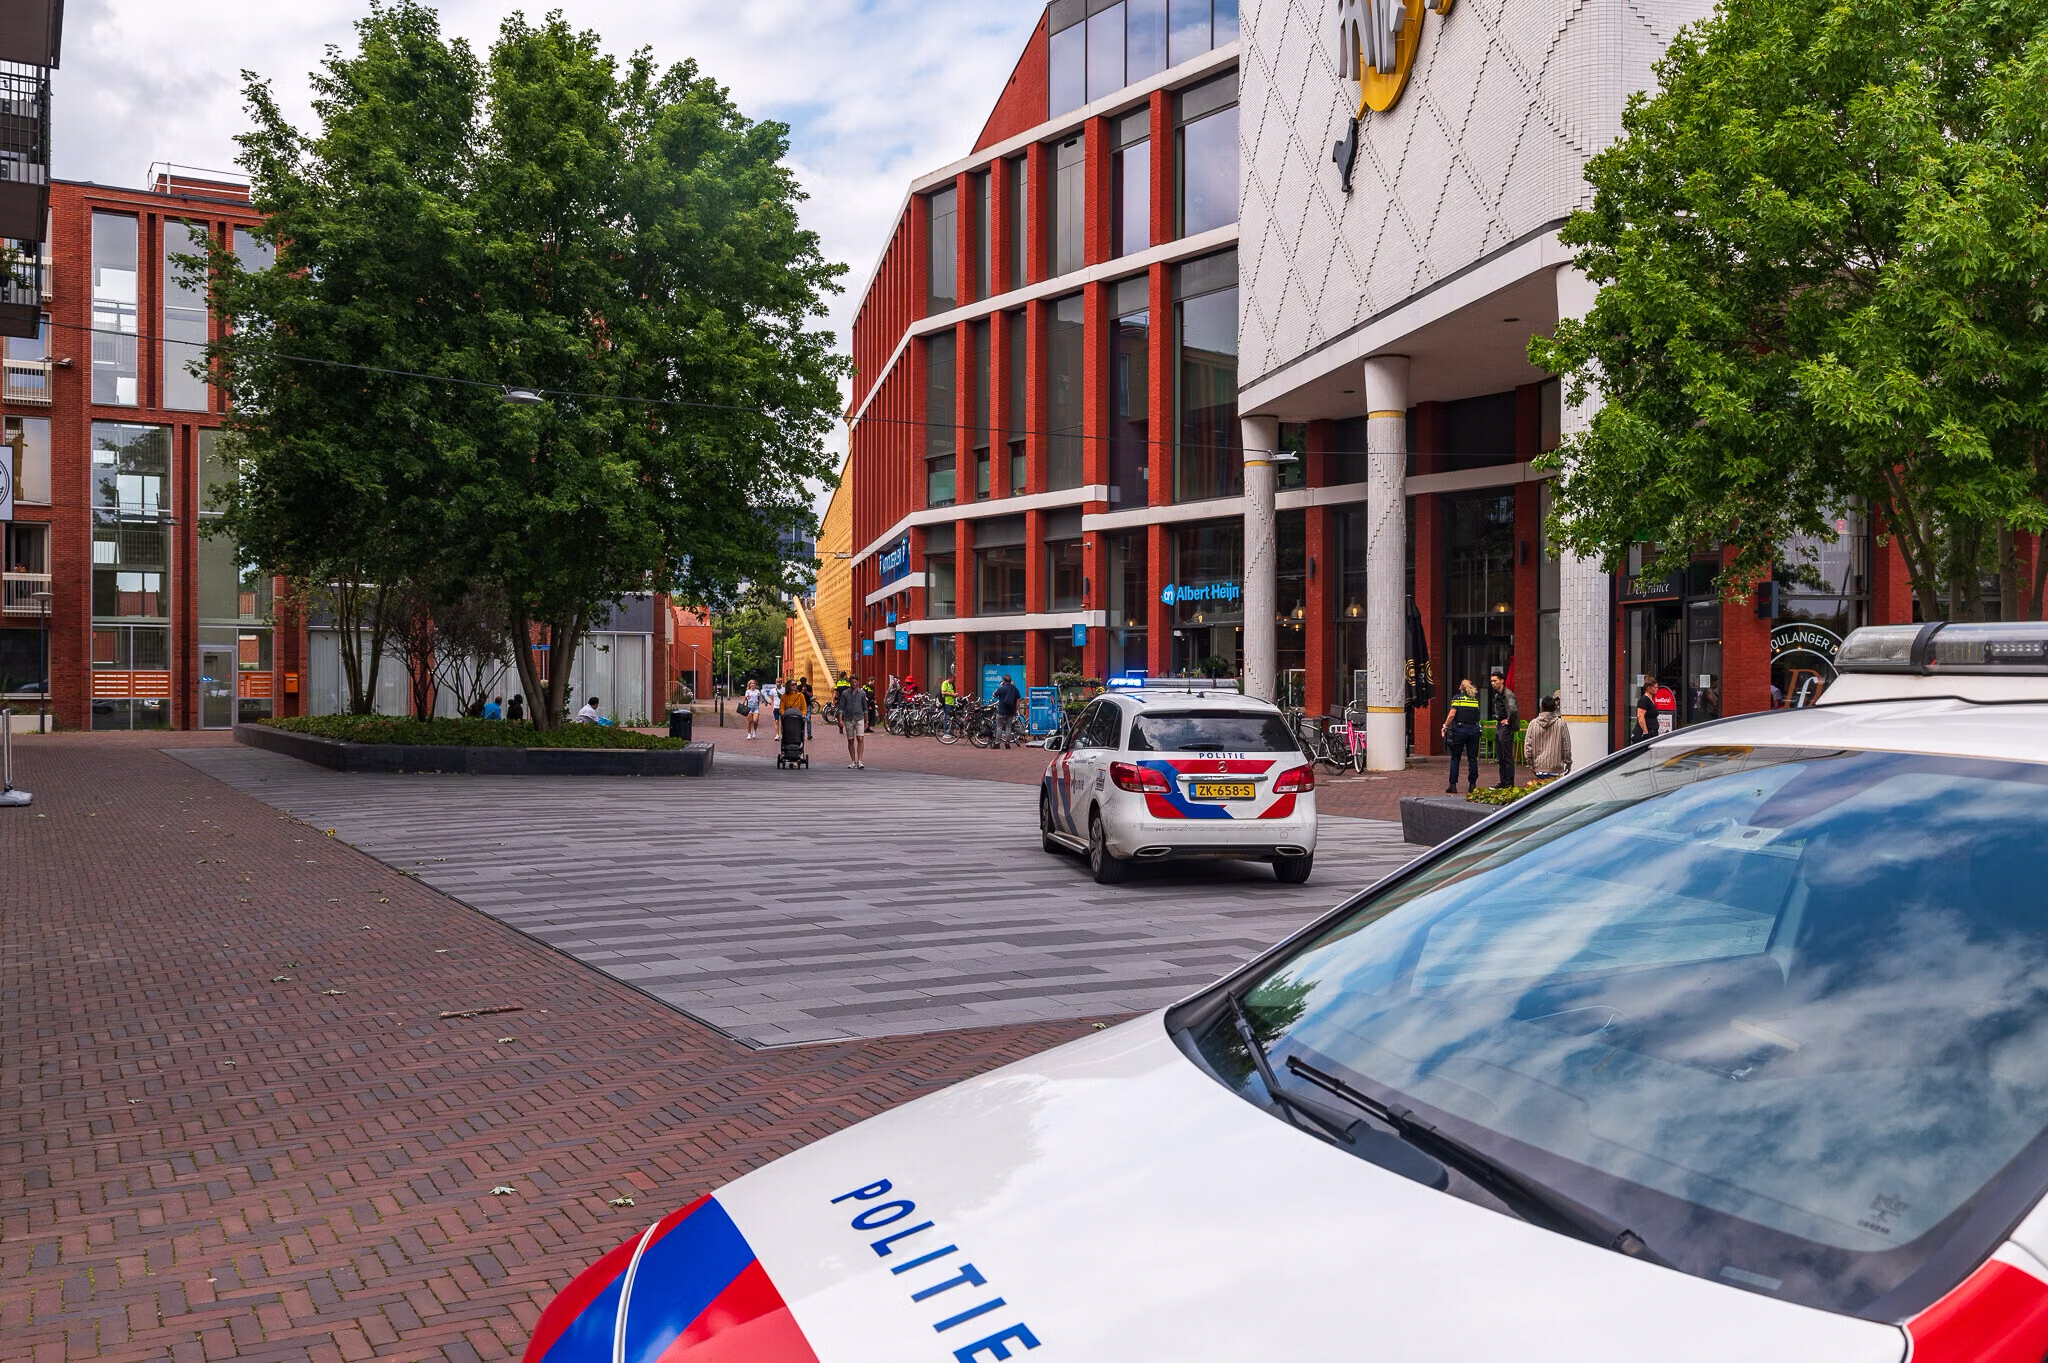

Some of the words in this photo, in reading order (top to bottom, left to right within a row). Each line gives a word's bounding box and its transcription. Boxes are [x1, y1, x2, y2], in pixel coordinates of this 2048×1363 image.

[1176, 585, 1210, 601] Albert
[1212, 582, 1240, 602] Heijn
[1771, 632, 1830, 652] OULANGER
[1199, 785, 1251, 796] ZK-658-S
[830, 1178, 1042, 1363] POLITIE
